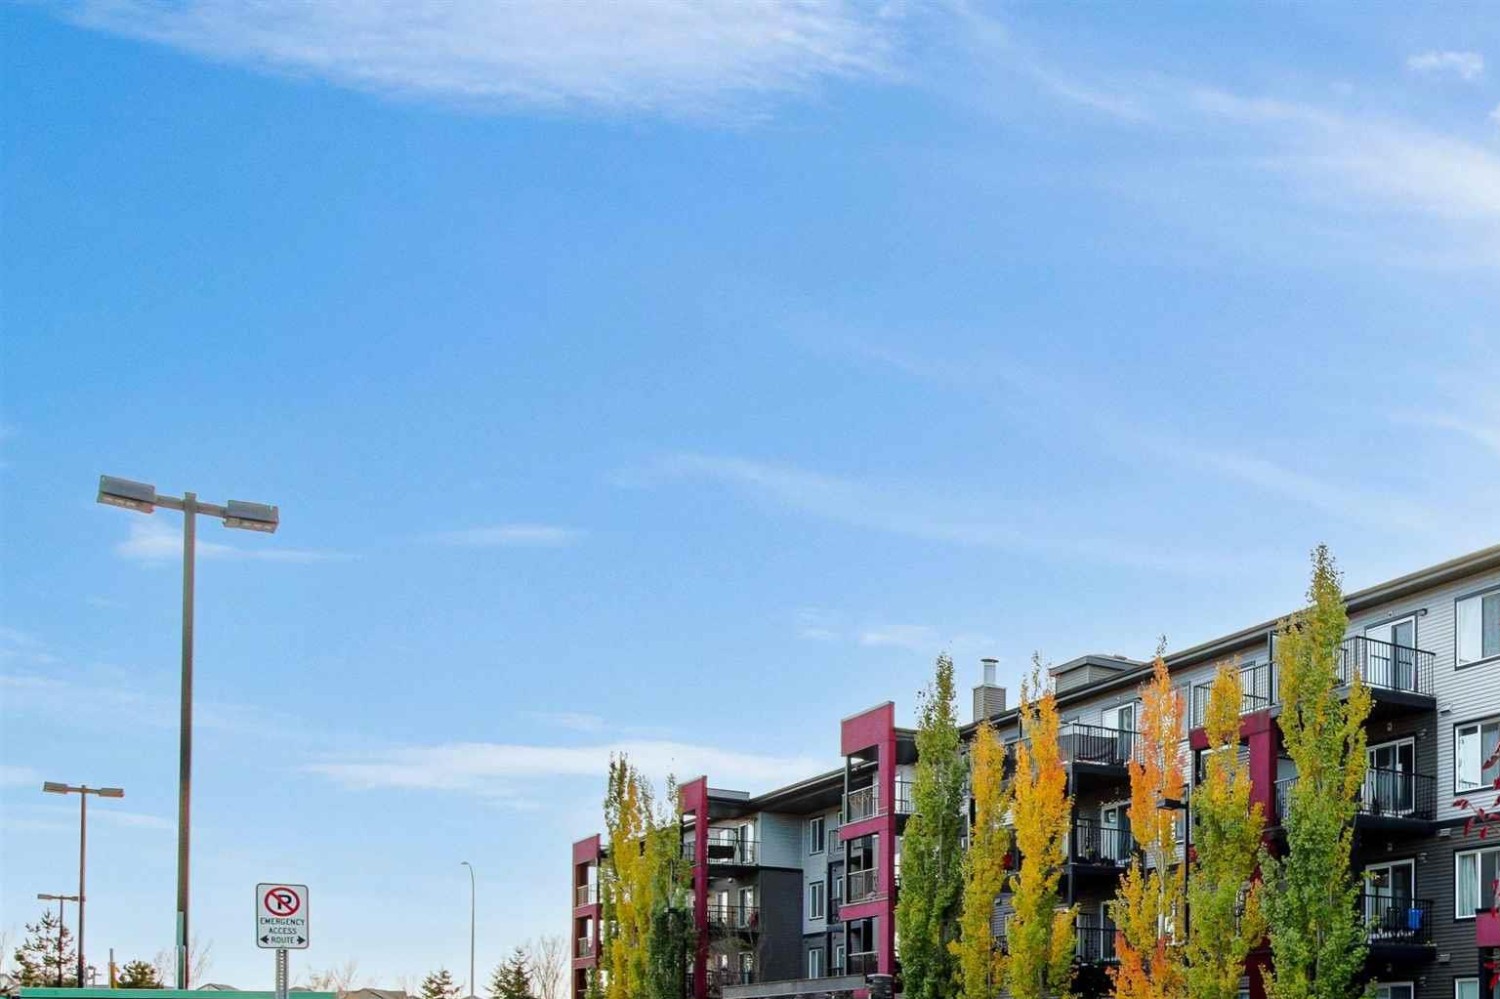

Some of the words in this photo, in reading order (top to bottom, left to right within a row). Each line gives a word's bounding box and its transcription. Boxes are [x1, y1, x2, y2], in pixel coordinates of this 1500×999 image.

[260, 917, 305, 926] EMERGENCY
[269, 926, 297, 935] ACCESS
[270, 936, 295, 944] ROUTE
